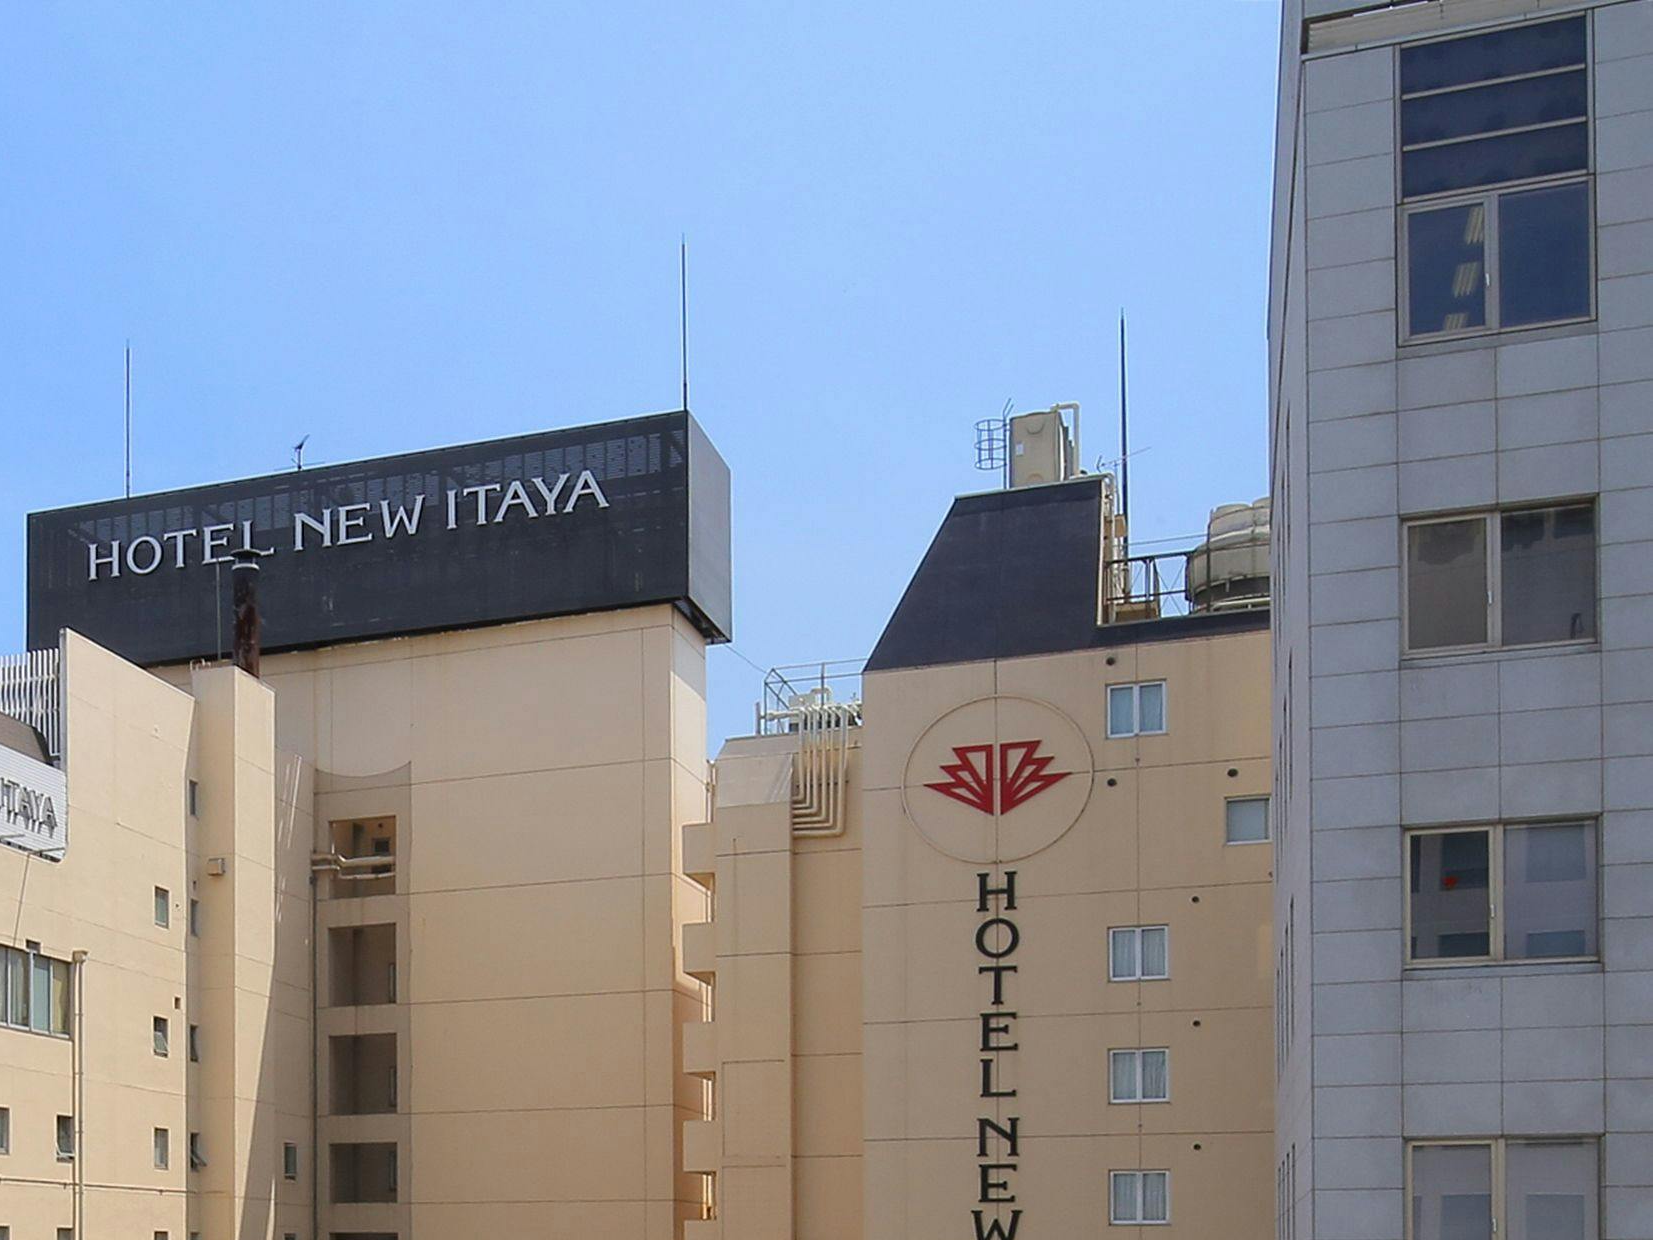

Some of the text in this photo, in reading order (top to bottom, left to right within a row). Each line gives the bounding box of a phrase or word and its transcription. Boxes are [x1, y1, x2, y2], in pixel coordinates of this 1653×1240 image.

[88, 469, 610, 580] HOTEL NEW ITAYA
[974, 870, 1020, 1098] HOTEL
